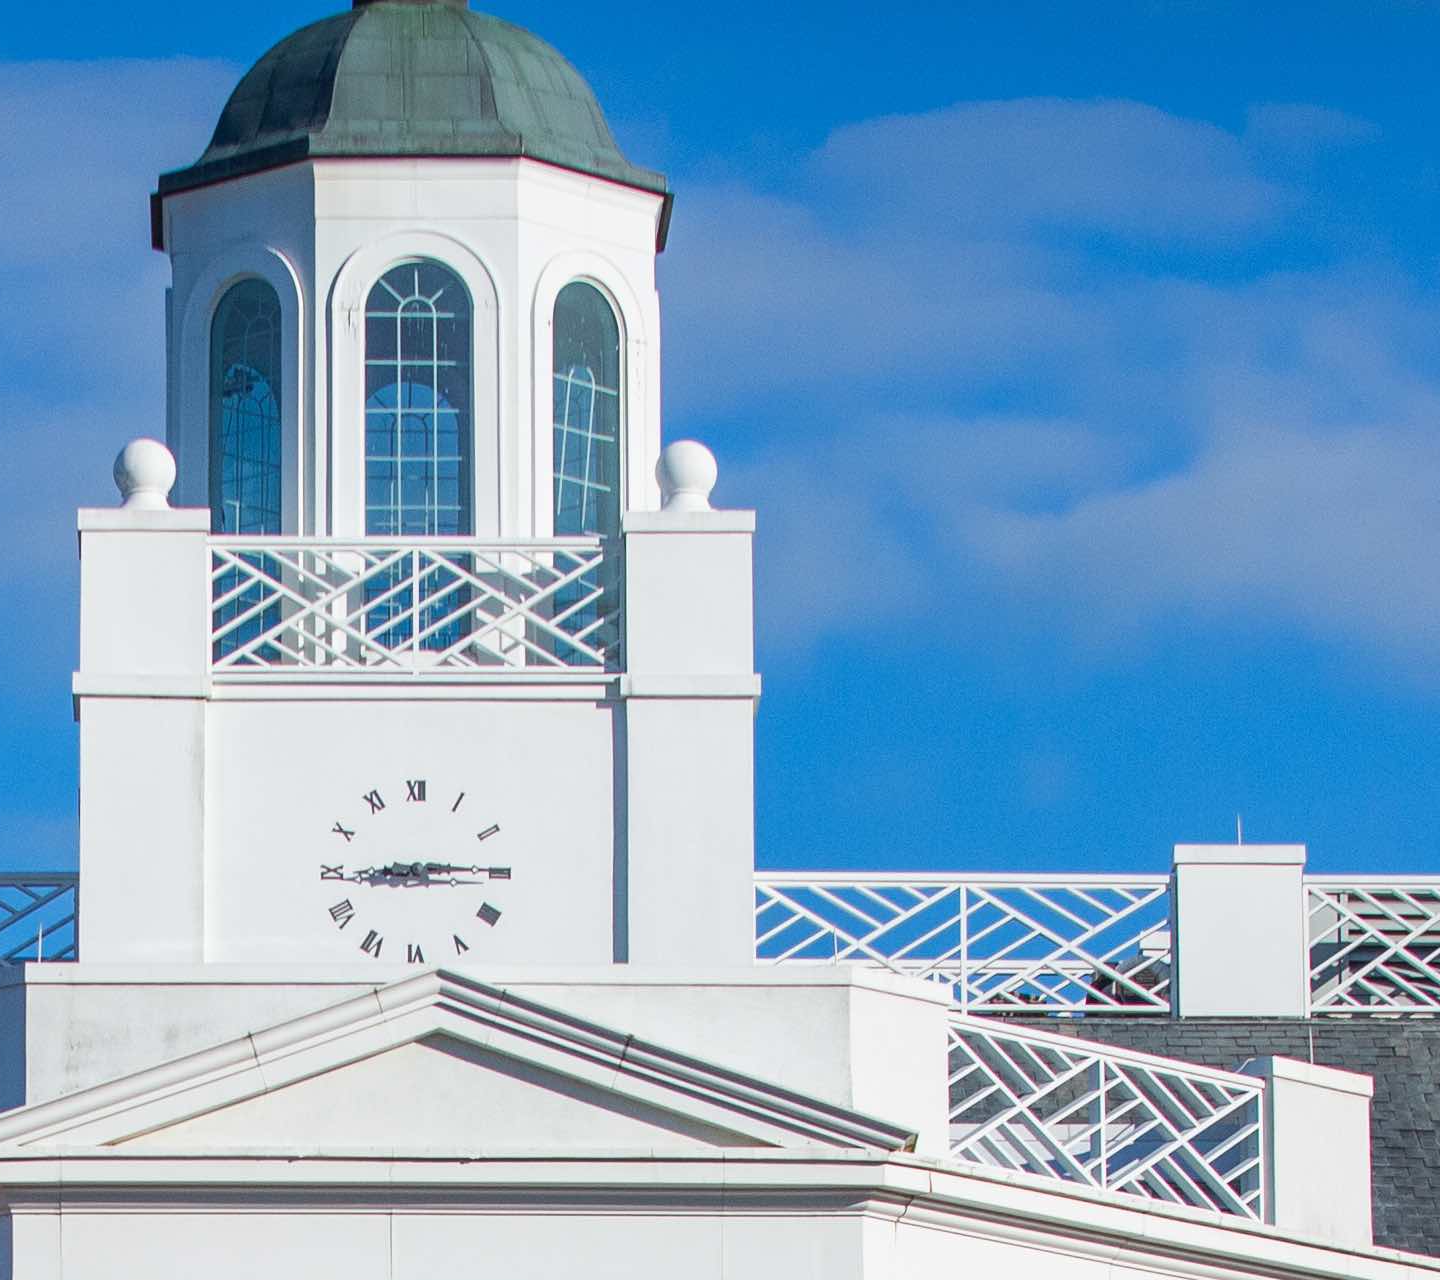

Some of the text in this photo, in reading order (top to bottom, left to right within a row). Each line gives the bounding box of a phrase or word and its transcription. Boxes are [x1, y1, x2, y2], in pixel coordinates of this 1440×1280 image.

[406, 780, 426, 801] XII
[363, 789, 385, 814] XI
[452, 792, 465, 812] I
[332, 822, 355, 842] X
[477, 824, 500, 841] II
[320, 865, 344, 880] IX
[328, 898, 355, 930] VIII
[360, 929, 384, 958] VII
[408, 944, 425, 963] VI
[453, 934, 470, 955] V
